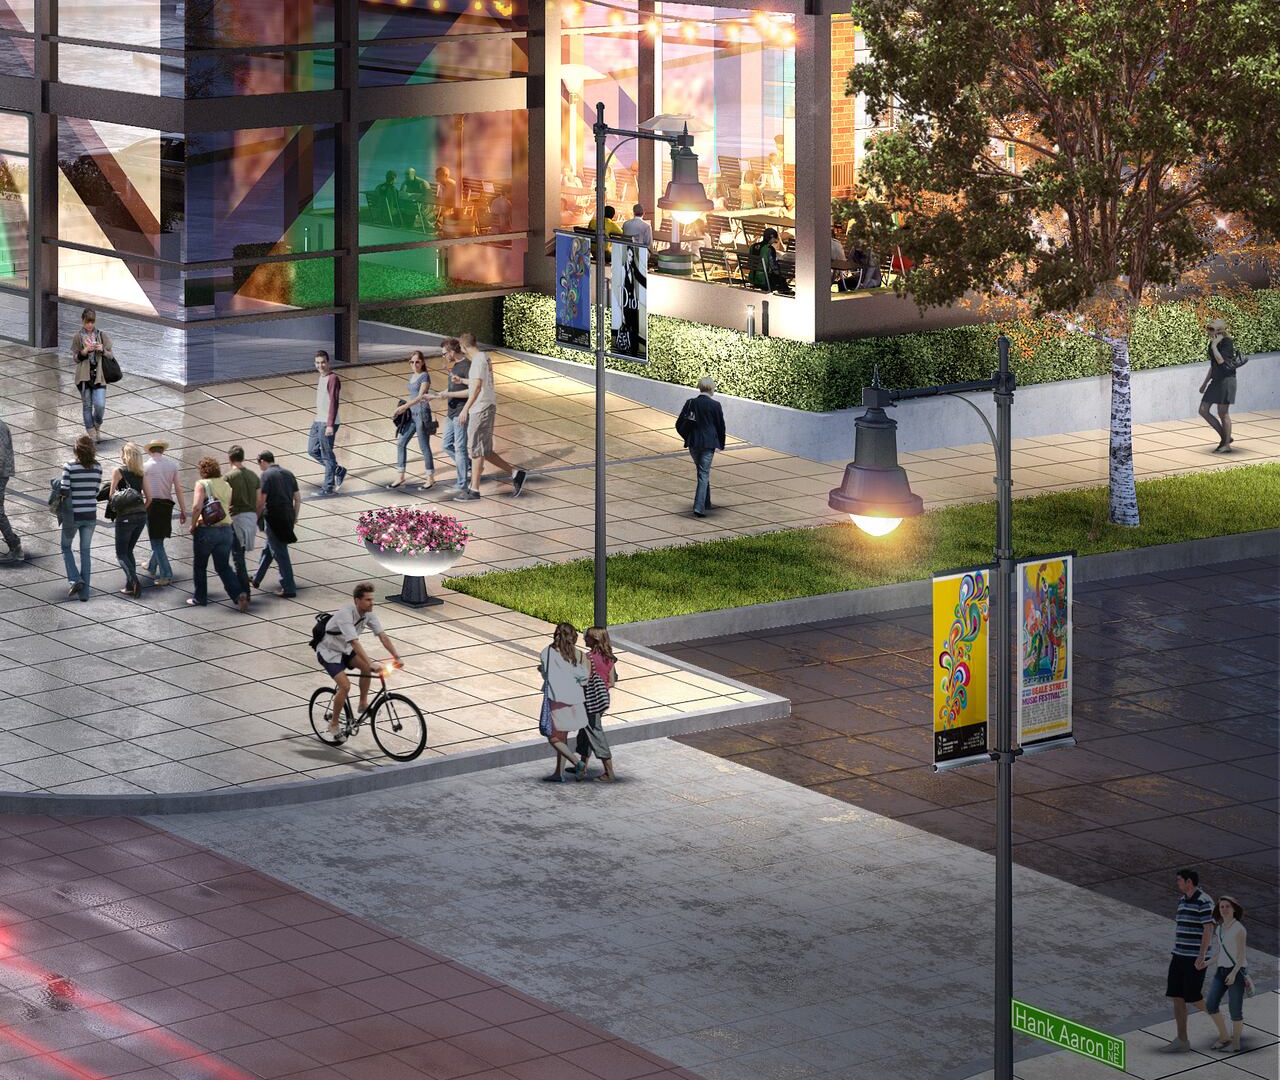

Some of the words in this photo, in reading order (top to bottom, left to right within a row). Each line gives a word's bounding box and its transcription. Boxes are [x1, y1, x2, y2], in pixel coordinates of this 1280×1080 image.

[1015, 1006, 1055, 1040] Hank
[1059, 1024, 1105, 1059] Aaron
[1107, 1040, 1121, 1054] DR
[1107, 1050, 1121, 1065] NE
